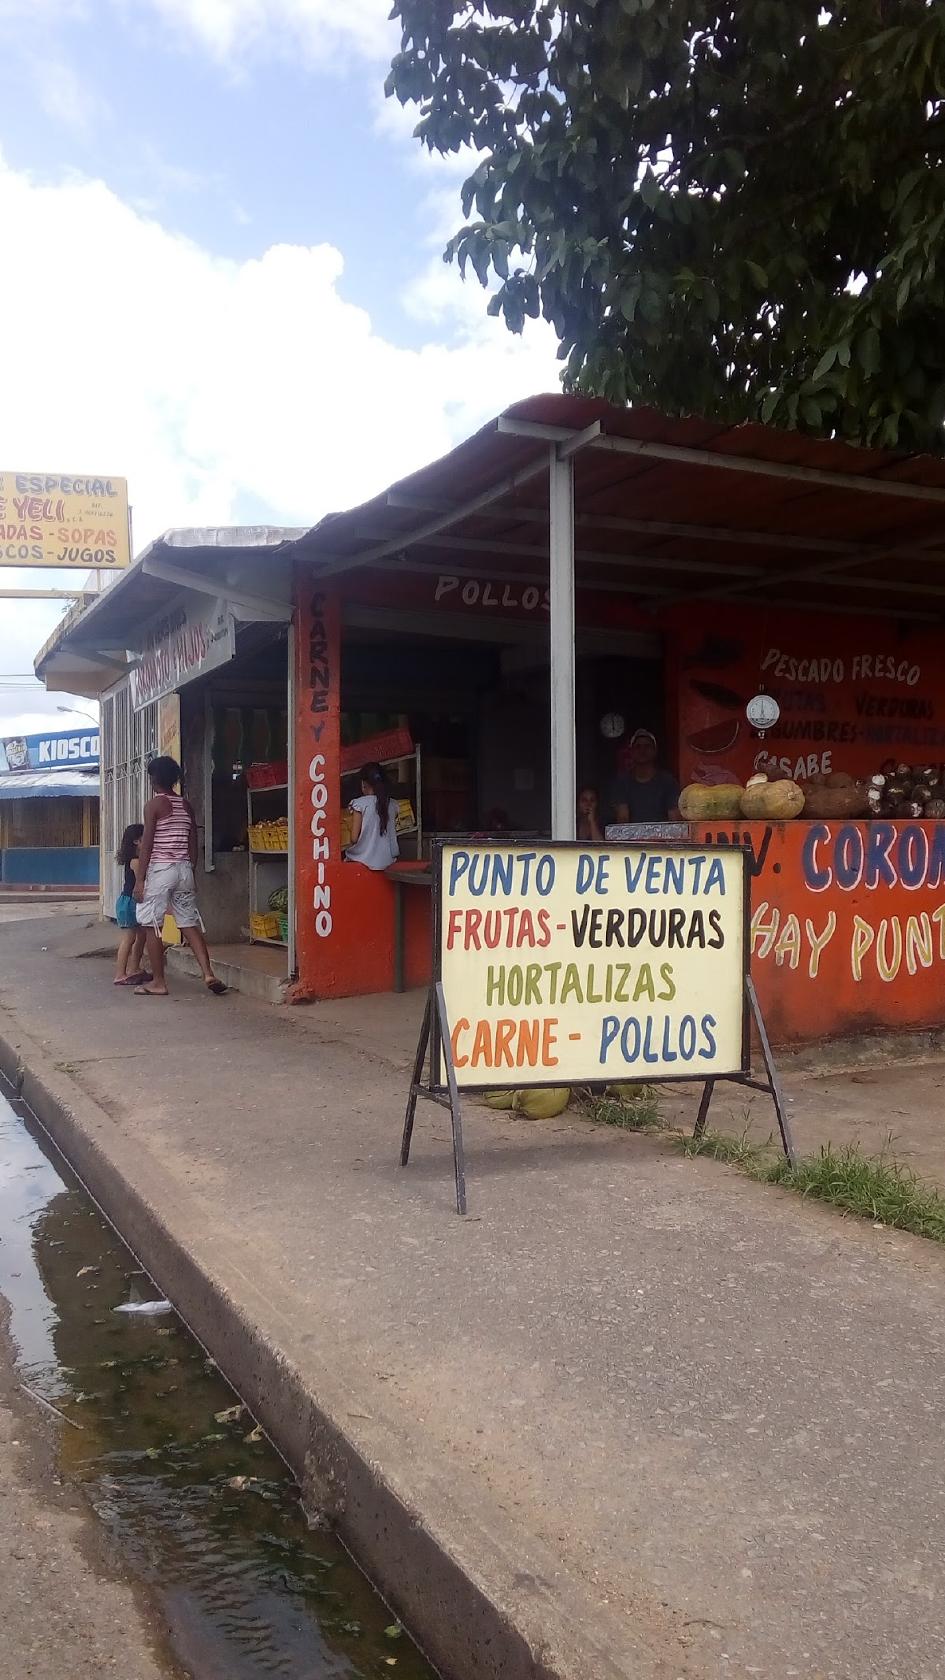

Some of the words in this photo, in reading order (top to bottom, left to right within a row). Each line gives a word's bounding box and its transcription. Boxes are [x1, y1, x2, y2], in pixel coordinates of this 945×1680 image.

[15, 474, 118, 498] ESPECIAL
[13, 495, 65, 523] YELI
[0, 543, 44, 560] COS
[57, 546, 117, 564] JUGOS
[57, 526, 118, 547] SOPAS
[309, 591, 331, 714] CARNE
[760, 648, 845, 684] PESCADO
[852, 653, 921, 686] FRESCO
[39, 735, 100, 763] KIOSCO
[310, 719, 326, 744] Y
[308, 753, 333, 938] COCHINO
[448, 851, 556, 897] PUNTO
[575, 854, 610, 895] DE
[624, 852, 726, 896] VENTA
[750, 901, 837, 979] HAY
[486, 961, 677, 1007] HORTALIZAS
[451, 1017, 559, 1068] CARNE
[599, 1013, 718, 1065] POLLOS
